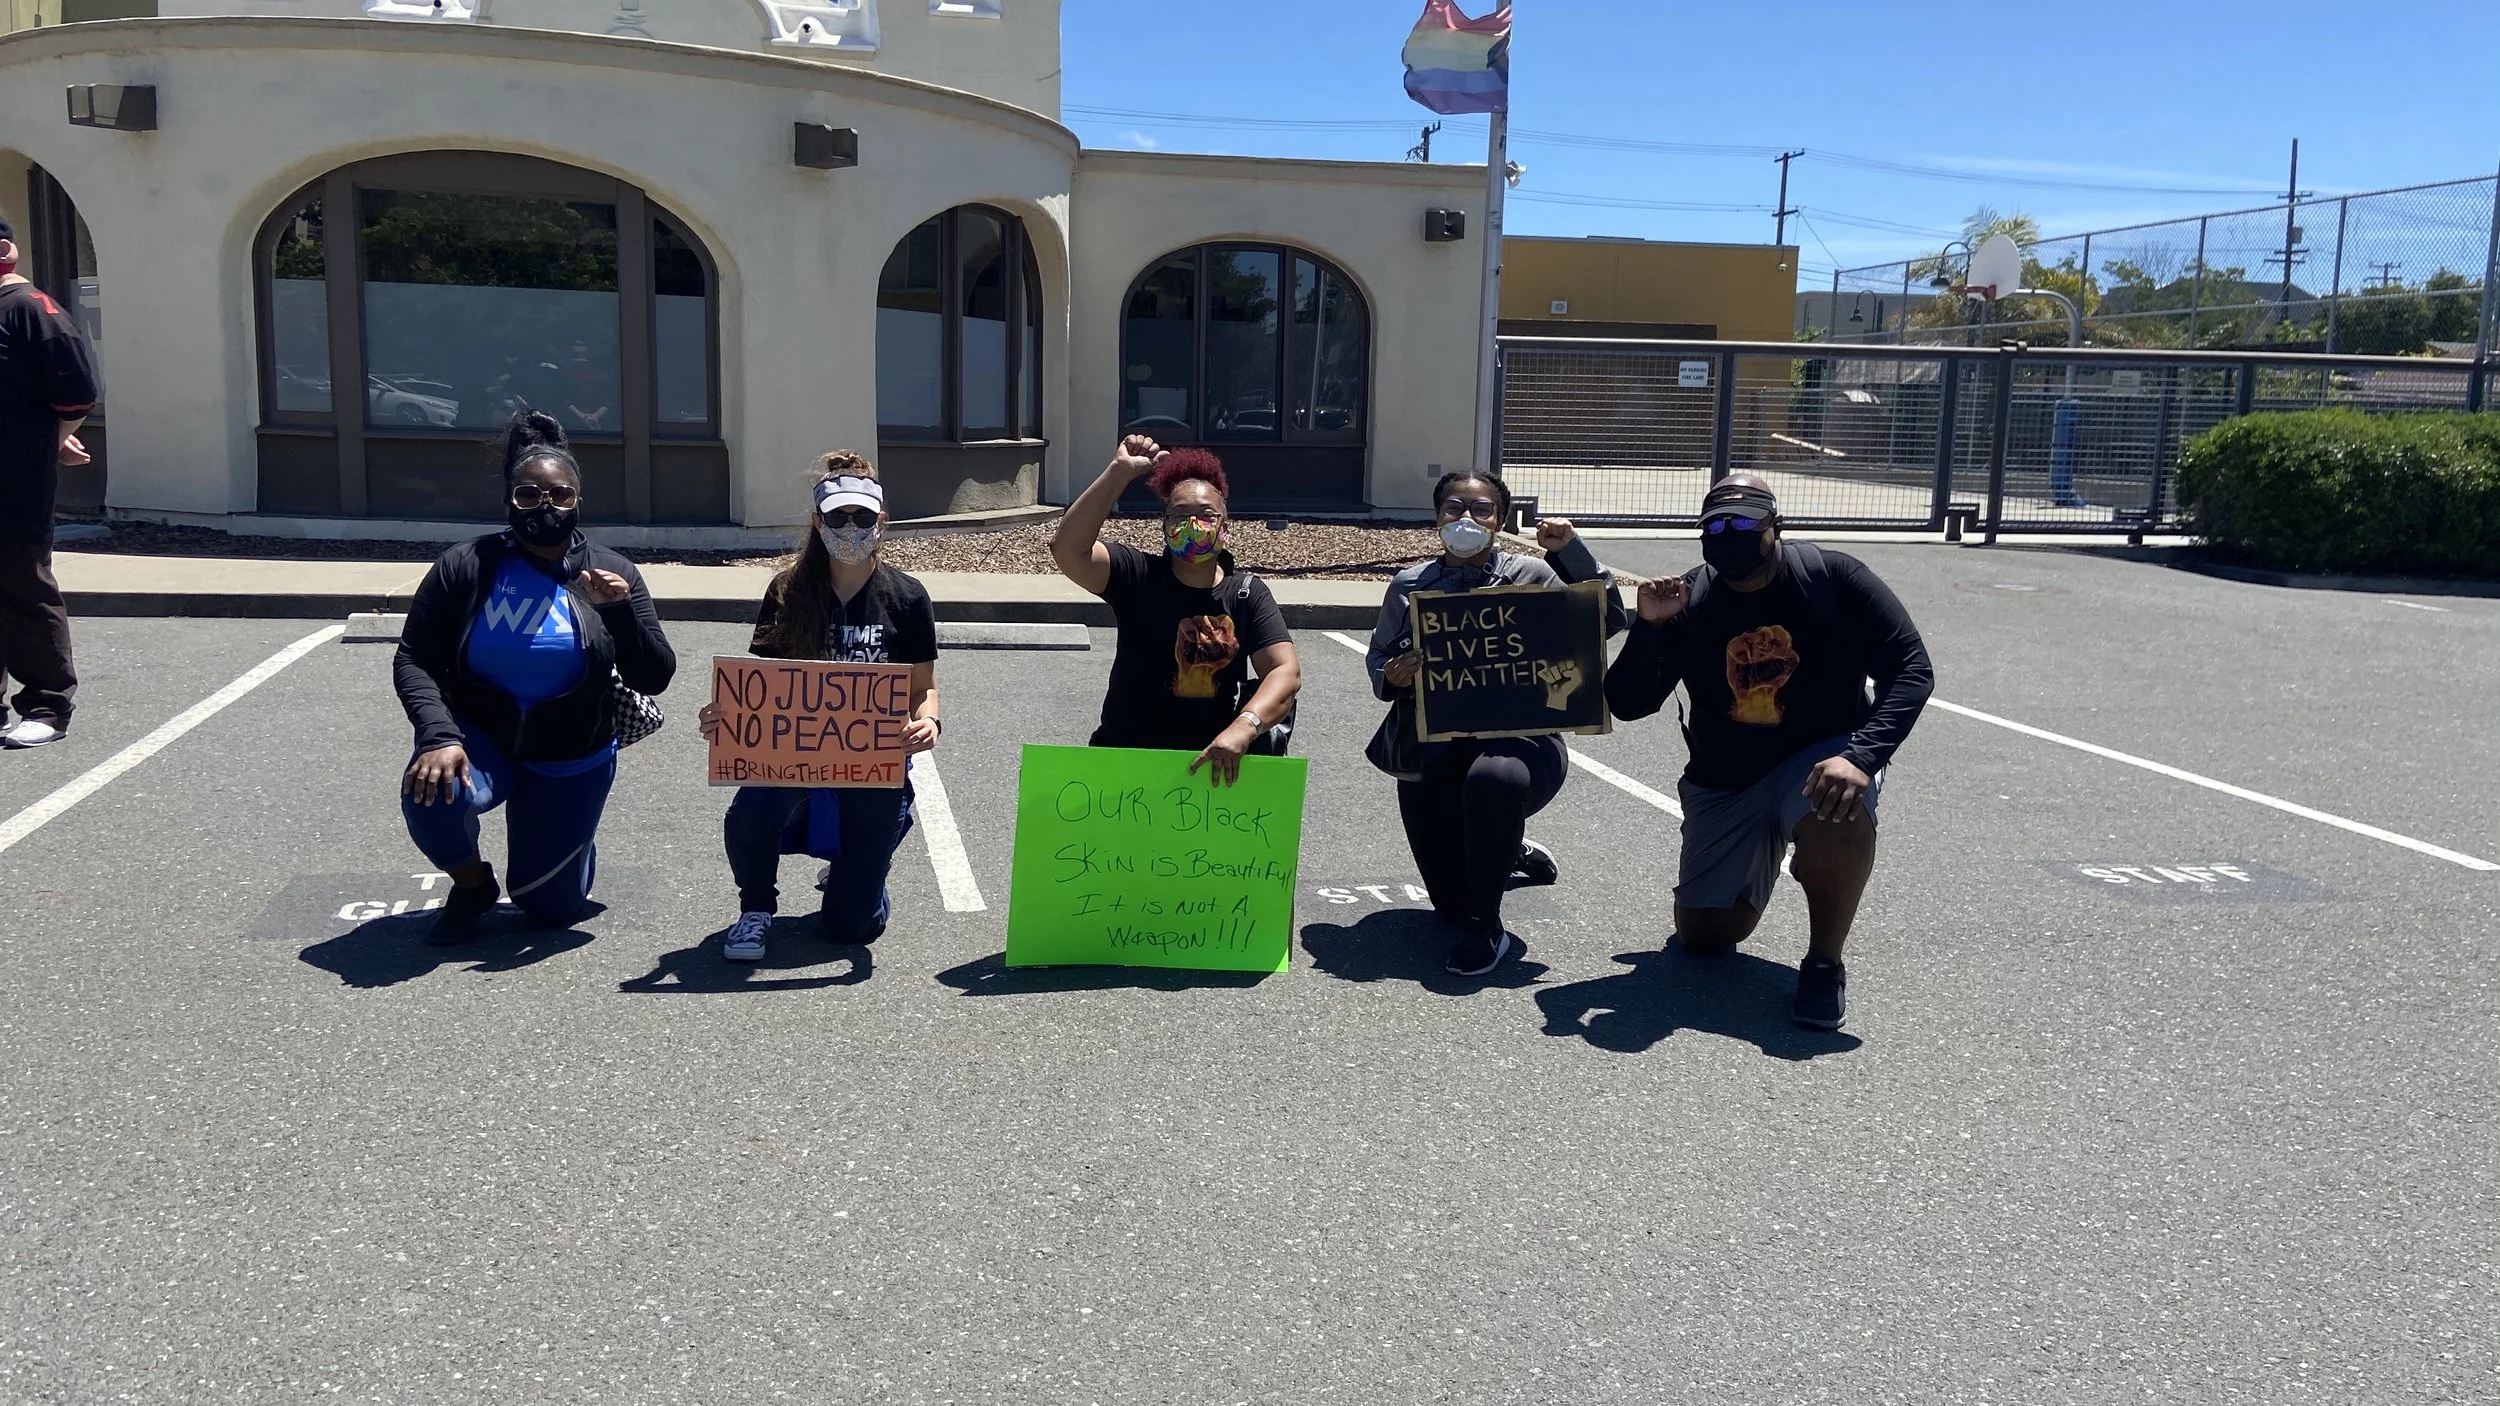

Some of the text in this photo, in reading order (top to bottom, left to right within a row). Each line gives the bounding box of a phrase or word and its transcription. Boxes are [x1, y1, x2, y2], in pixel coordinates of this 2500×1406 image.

[496, 583, 517, 595] THE
[1421, 605, 1517, 635] BLACK
[1426, 633, 1525, 662] LIVES
[1429, 659, 1550, 692] MATTER
[715, 666, 909, 717] NO JUSTICE
[714, 712, 903, 753] NO PEACE
[715, 757, 900, 783] #BRINGTHEHEAT
[1056, 780, 1273, 849] OUR Black
[2080, 863, 2252, 884] STAFF
[1071, 893, 1126, 917] It
[1231, 894, 1249, 917] A
